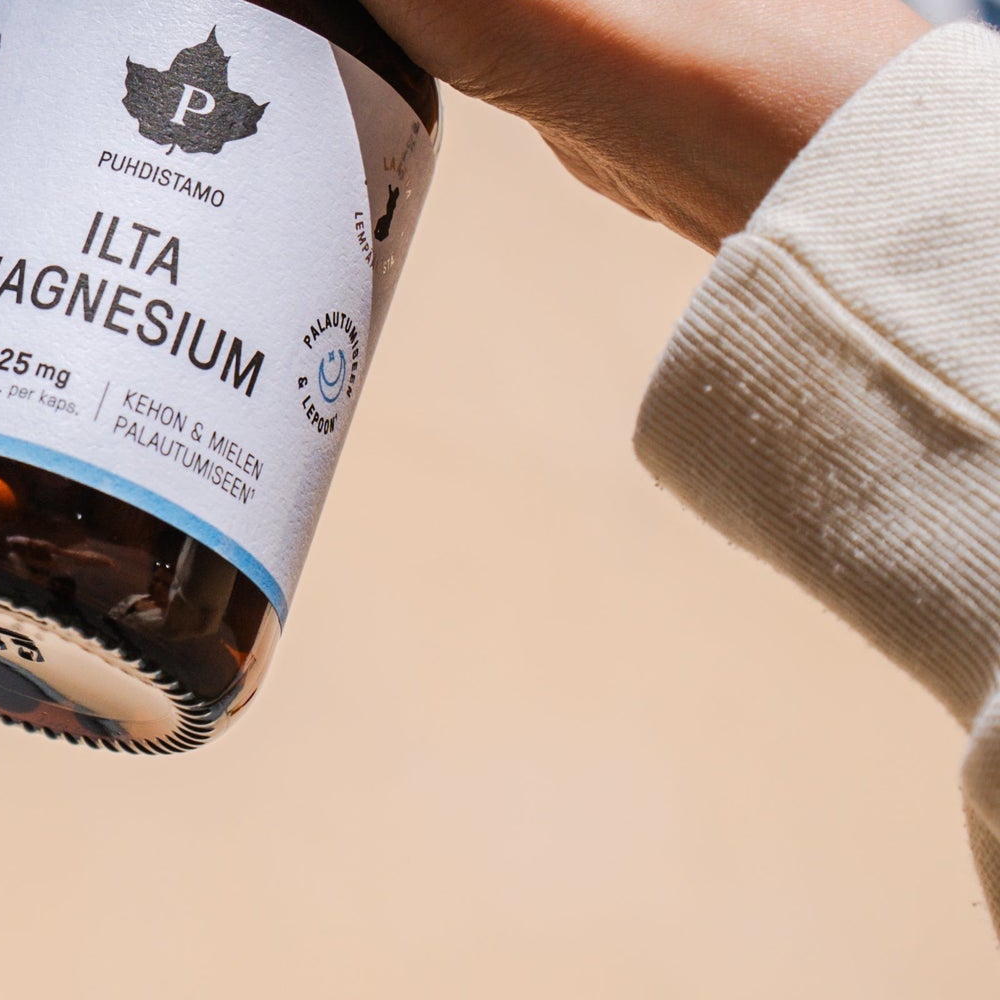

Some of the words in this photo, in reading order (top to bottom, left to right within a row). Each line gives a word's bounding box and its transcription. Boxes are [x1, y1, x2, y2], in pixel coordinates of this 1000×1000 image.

[169, 83, 216, 126] P
[97, 151, 225, 207] PUHDISTAMO
[81, 211, 181, 286] ILTA
[35, 362, 72, 389] mg
[303, 311, 359, 398] PALAUTUMISEEN
[7, 382, 34, 399] per
[38, 387, 79, 416] kaps.
[122, 388, 188, 433] KEHON
[190, 421, 204, 442] &
[208, 431, 264, 481] MIELEN
